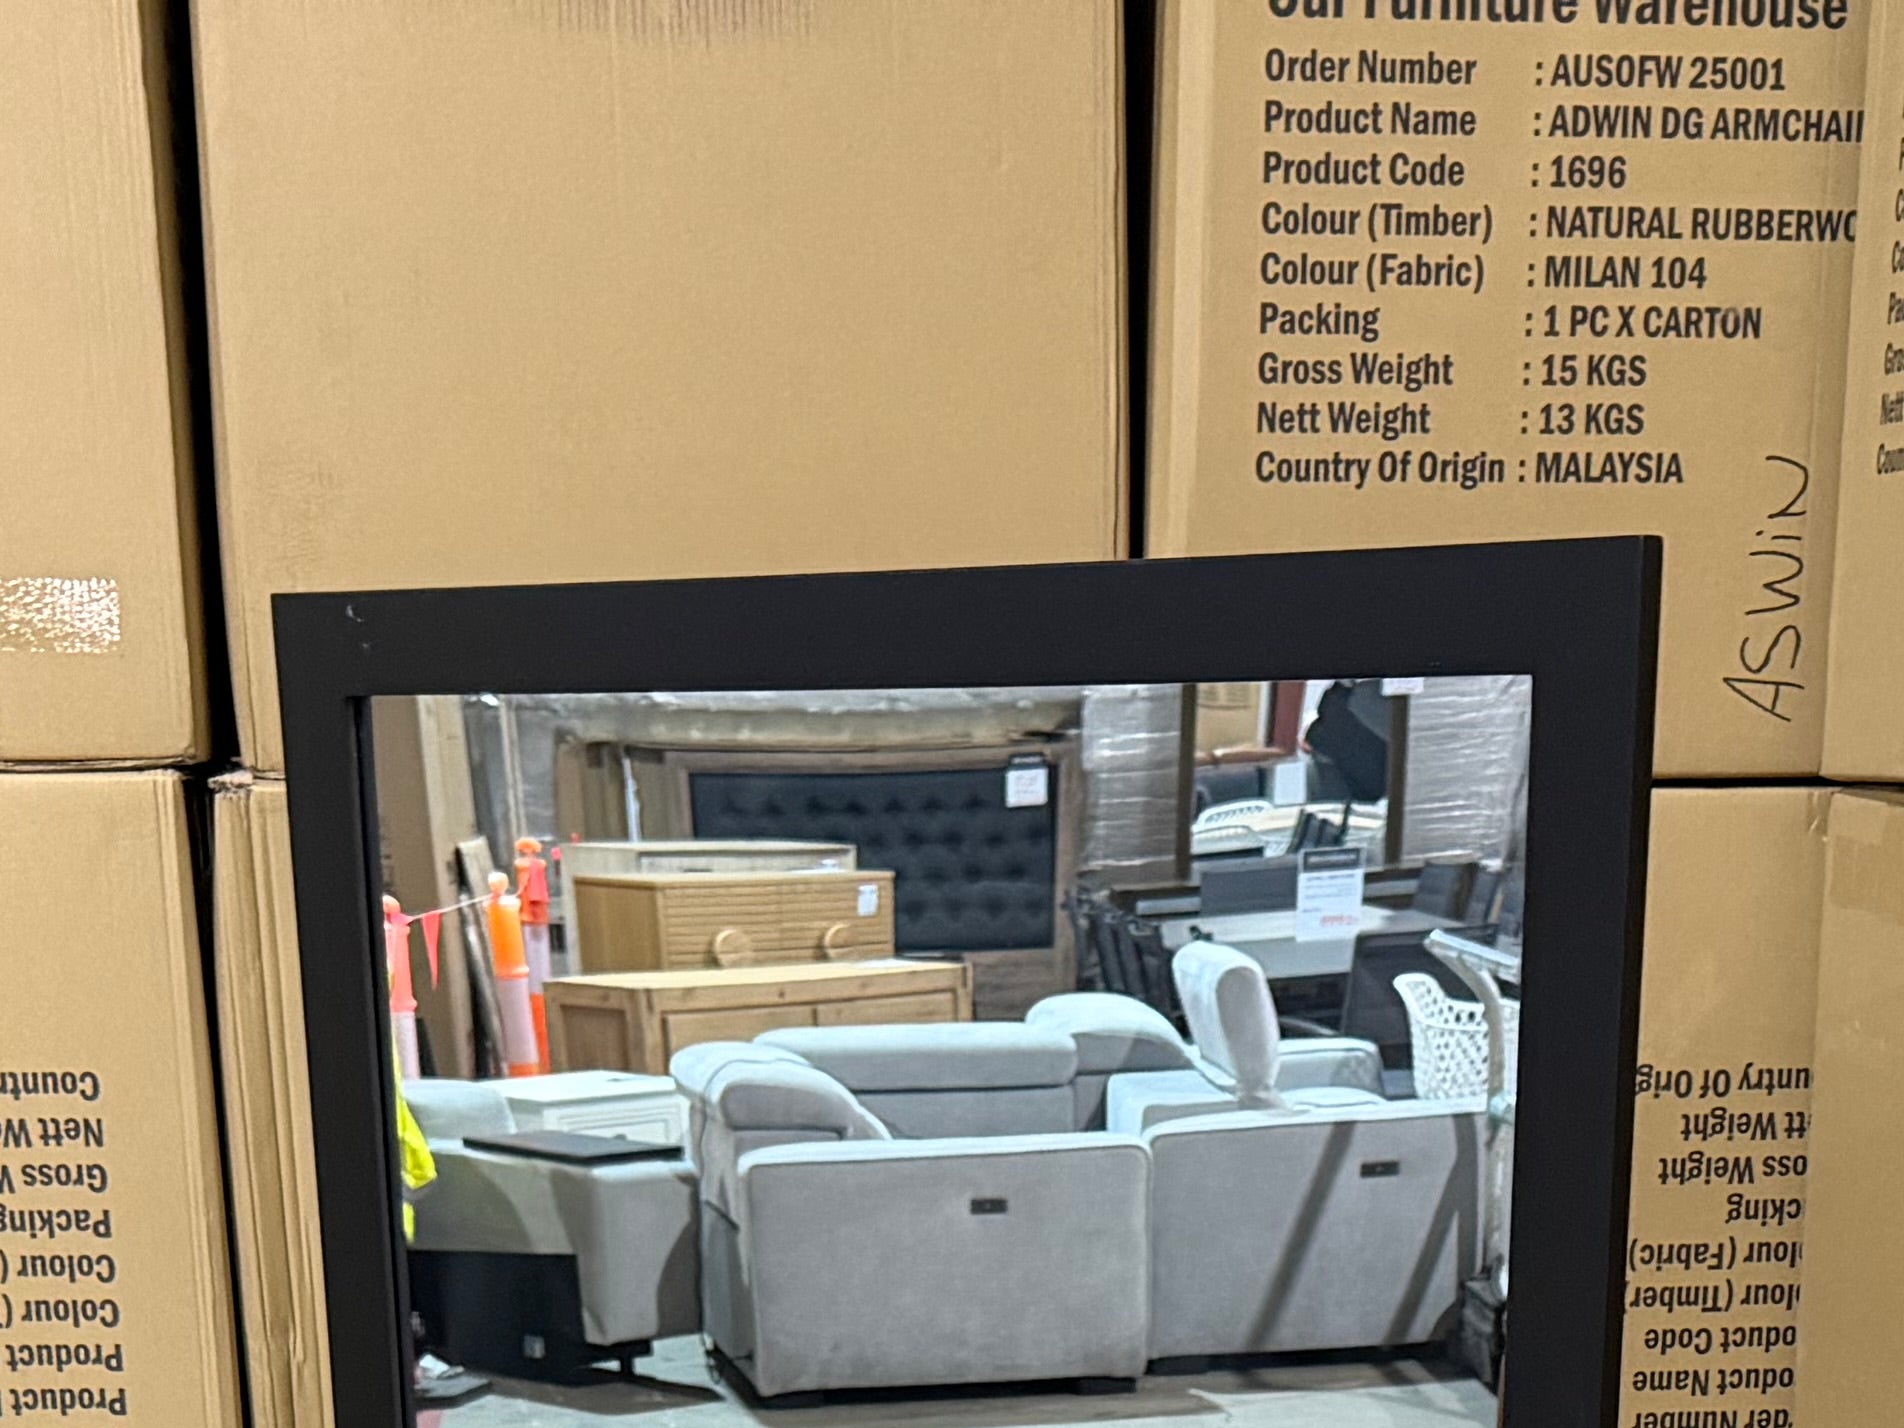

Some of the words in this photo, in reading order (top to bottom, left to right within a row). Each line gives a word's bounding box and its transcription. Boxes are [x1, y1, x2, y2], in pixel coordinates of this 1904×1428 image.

[1265, 48, 1350, 82] Order
[1358, 50, 1477, 84] Number
[1551, 54, 1683, 88] AUSOFW
[1689, 57, 1785, 90] 25001
[1265, 100, 1382, 134] Product
[1391, 102, 1476, 136] Name
[1548, 105, 1651, 138] ADWIN
[1661, 107, 1703, 139] DG
[1264, 151, 1381, 185] Product
[1389, 153, 1464, 186] Code
[1550, 155, 1626, 188] 1696
[1262, 202, 1360, 235] Colour
[1368, 203, 1492, 244] (Timber)
[1547, 206, 1682, 239] NATURAL
[1691, 208, 1857, 243] RUBBERWO
[1261, 252, 1359, 285] Colour
[1367, 253, 1483, 294] (Fabric)
[1545, 256, 1640, 288] MILAN
[1651, 256, 1707, 289] 104
[1260, 302, 1380, 342] Packing
[1544, 305, 1559, 337] 1
[1570, 305, 1609, 337] PC
[1615, 306, 1635, 337] X
[1643, 306, 1761, 339] CARTON
[1259, 352, 1342, 384] Gross
[1350, 352, 1453, 392] Weight
[1542, 354, 1577, 386] 15
[1587, 355, 1646, 386] KGS
[1257, 402, 1320, 433] Nett
[1328, 402, 1430, 441] Weight
[1539, 403, 1575, 435] 13
[1585, 403, 1644, 435] KGS
[1256, 451, 1371, 489] Country
[1378, 450, 1412, 482] Of
[1419, 451, 1504, 490] Origin
[1536, 452, 1683, 483] MALAYSIA
[1699, 1069, 1731, 1099] Of
[1737, 1062, 1813, 1092] untry
[1725, 1193, 1802, 1226] cking
[1644, 1328, 1712, 1355] Code
[1720, 1326, 1796, 1353] oduct
[1632, 1369, 1710, 1396] Name
[1716, 1367, 1794, 1393] oduct
